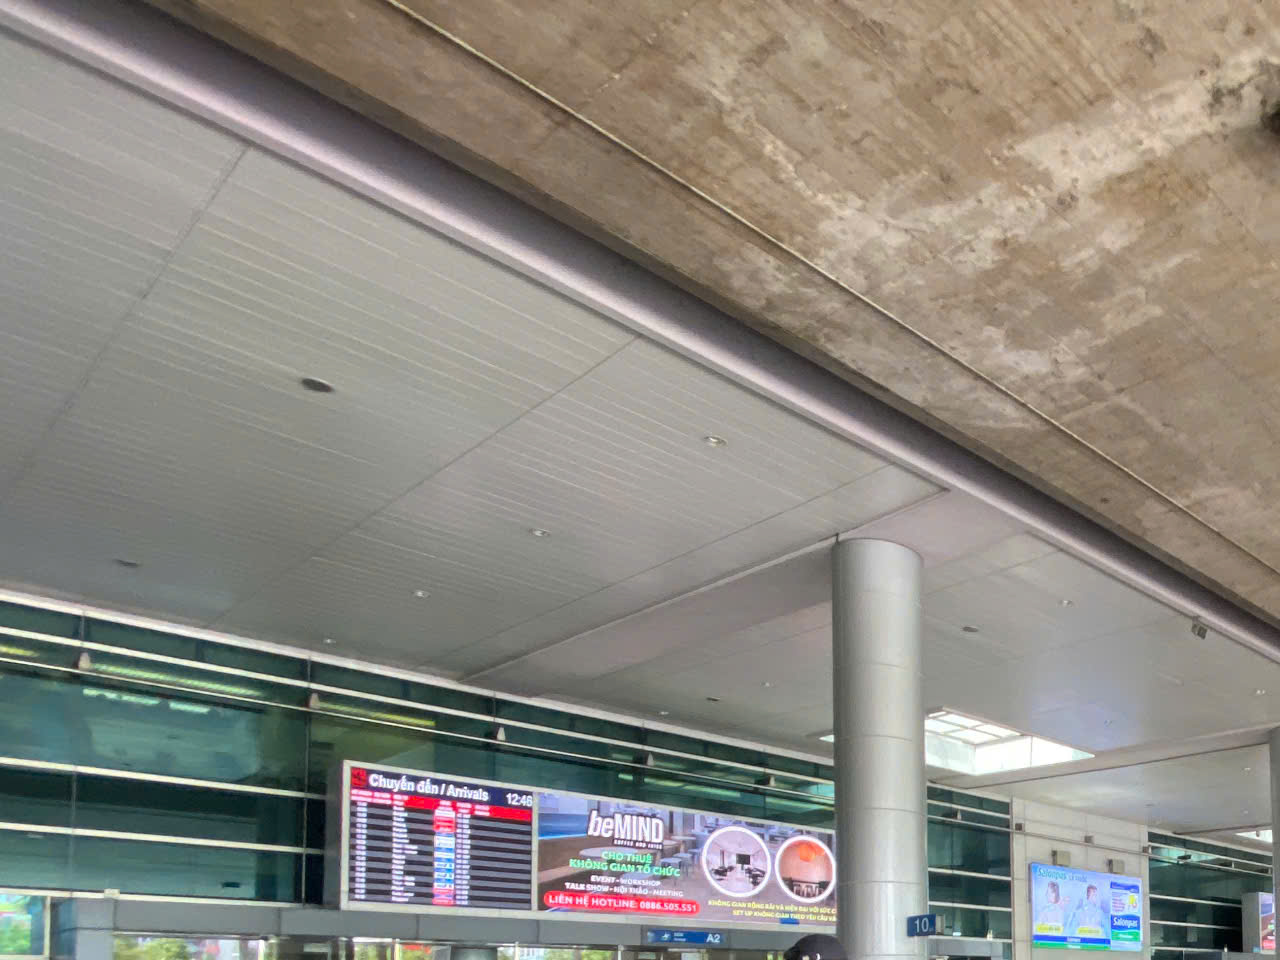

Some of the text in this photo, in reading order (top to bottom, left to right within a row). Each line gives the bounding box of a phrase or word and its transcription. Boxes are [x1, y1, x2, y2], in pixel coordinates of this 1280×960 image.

[368, 773, 489, 802] Chuyến đến / Arrivals
[588, 810, 664, 843] beMIND
[569, 858, 609, 871] KHÔNG
[610, 862, 635, 873] GIAN
[601, 851, 653, 864] CHO THUÊ
[590, 875, 616, 883] EVENT
[620, 877, 661, 887] WORKSHOP
[565, 882, 586, 890] TALK
[586, 883, 609, 892] SHOW
[653, 889, 684, 898] MEETING
[548, 895, 574, 905] LIÊN
[575, 896, 589, 908] HỆ
[640, 901, 697, 912] 0886.505.551
[914, 917, 929, 933] 10
[706, 933, 721, 943] A2
